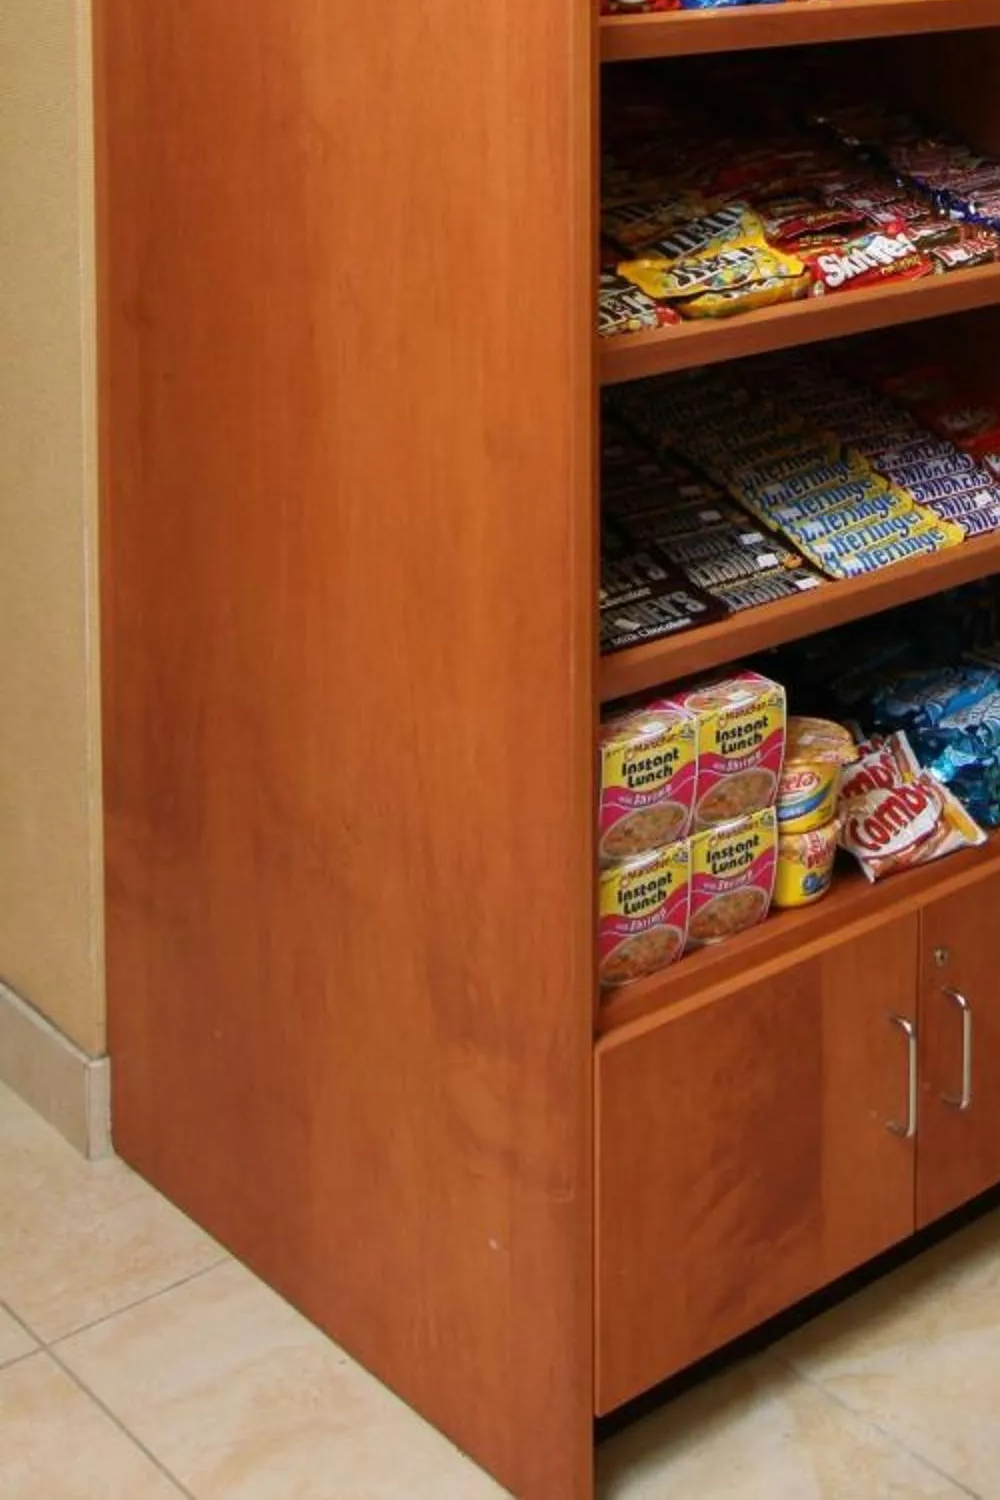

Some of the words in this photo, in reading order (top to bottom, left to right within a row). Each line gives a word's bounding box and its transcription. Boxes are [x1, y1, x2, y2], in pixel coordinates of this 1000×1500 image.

[715, 715, 769, 744] Instant
[721, 732, 764, 755] Lunch
[621, 746, 680, 778] Instant
[627, 765, 674, 788] Lunch
[705, 833, 760, 863] Instant
[711, 853, 755, 875] Lunch
[617, 871, 673, 905] Instant
[623, 888, 668, 916] Lunch
